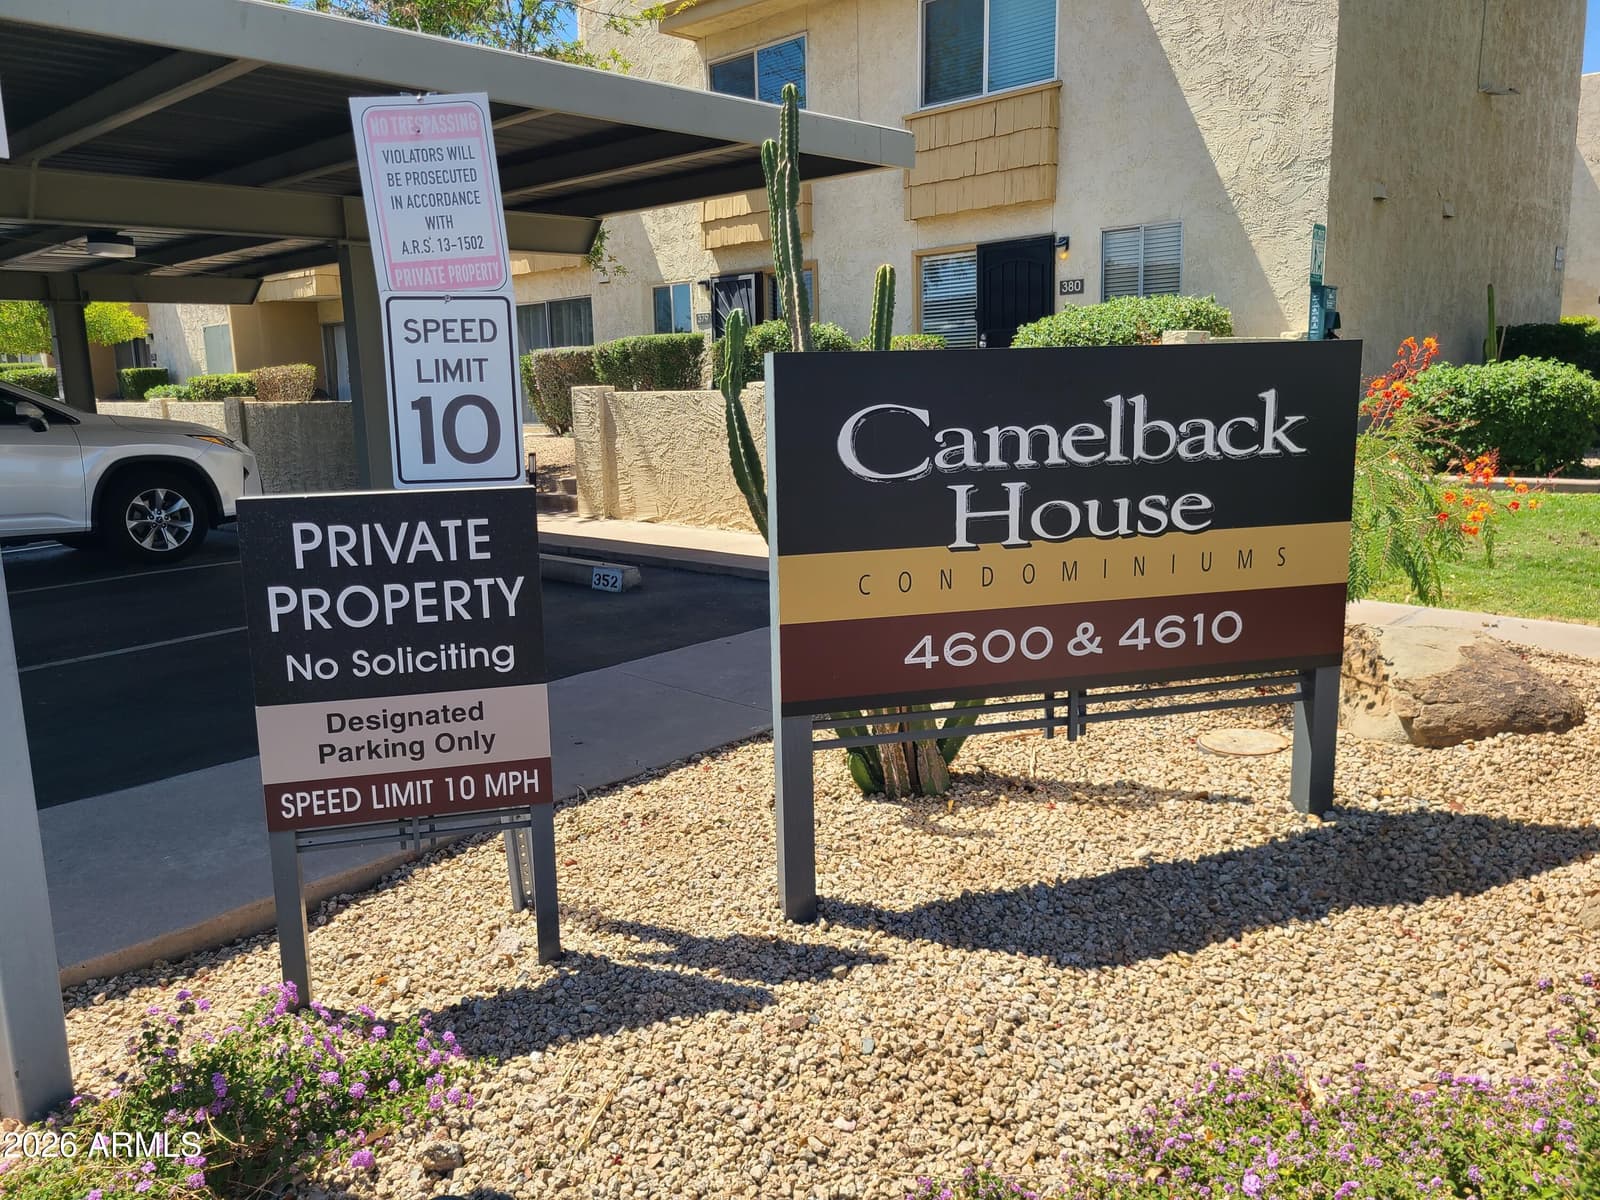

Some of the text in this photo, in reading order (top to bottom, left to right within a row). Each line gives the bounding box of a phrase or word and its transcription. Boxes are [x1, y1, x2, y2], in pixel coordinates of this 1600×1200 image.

[370, 112, 478, 137] NO TRESPASSING
[381, 145, 476, 165] VIOLATORS WILL
[387, 167, 477, 187] BE PROSECUTED
[390, 190, 481, 210] IN ACCORDANCE
[425, 215, 454, 231] WITH
[436, 235, 485, 252] 13-1502
[395, 261, 499, 287] PRIVATE PROPERTY
[1061, 280, 1081, 293] 380
[403, 318, 498, 344] SPEED
[416, 357, 489, 384] LIMIT
[410, 393, 502, 465] 10
[837, 387, 1308, 482] Camelback
[946, 479, 1215, 551] House
[291, 517, 492, 570] PRIVATE
[593, 572, 618, 589] 352
[857, 545, 1288, 596] CONDOMINIUMS
[266, 575, 526, 633] PROPERTY
[903, 609, 1244, 670] 4600 & 4610
[285, 641, 516, 683] No Soliciting
[325, 700, 485, 735] Designated
[317, 729, 497, 765] Parking Only
[280, 768, 540, 820] SPEED LIMIT 10 MPH
